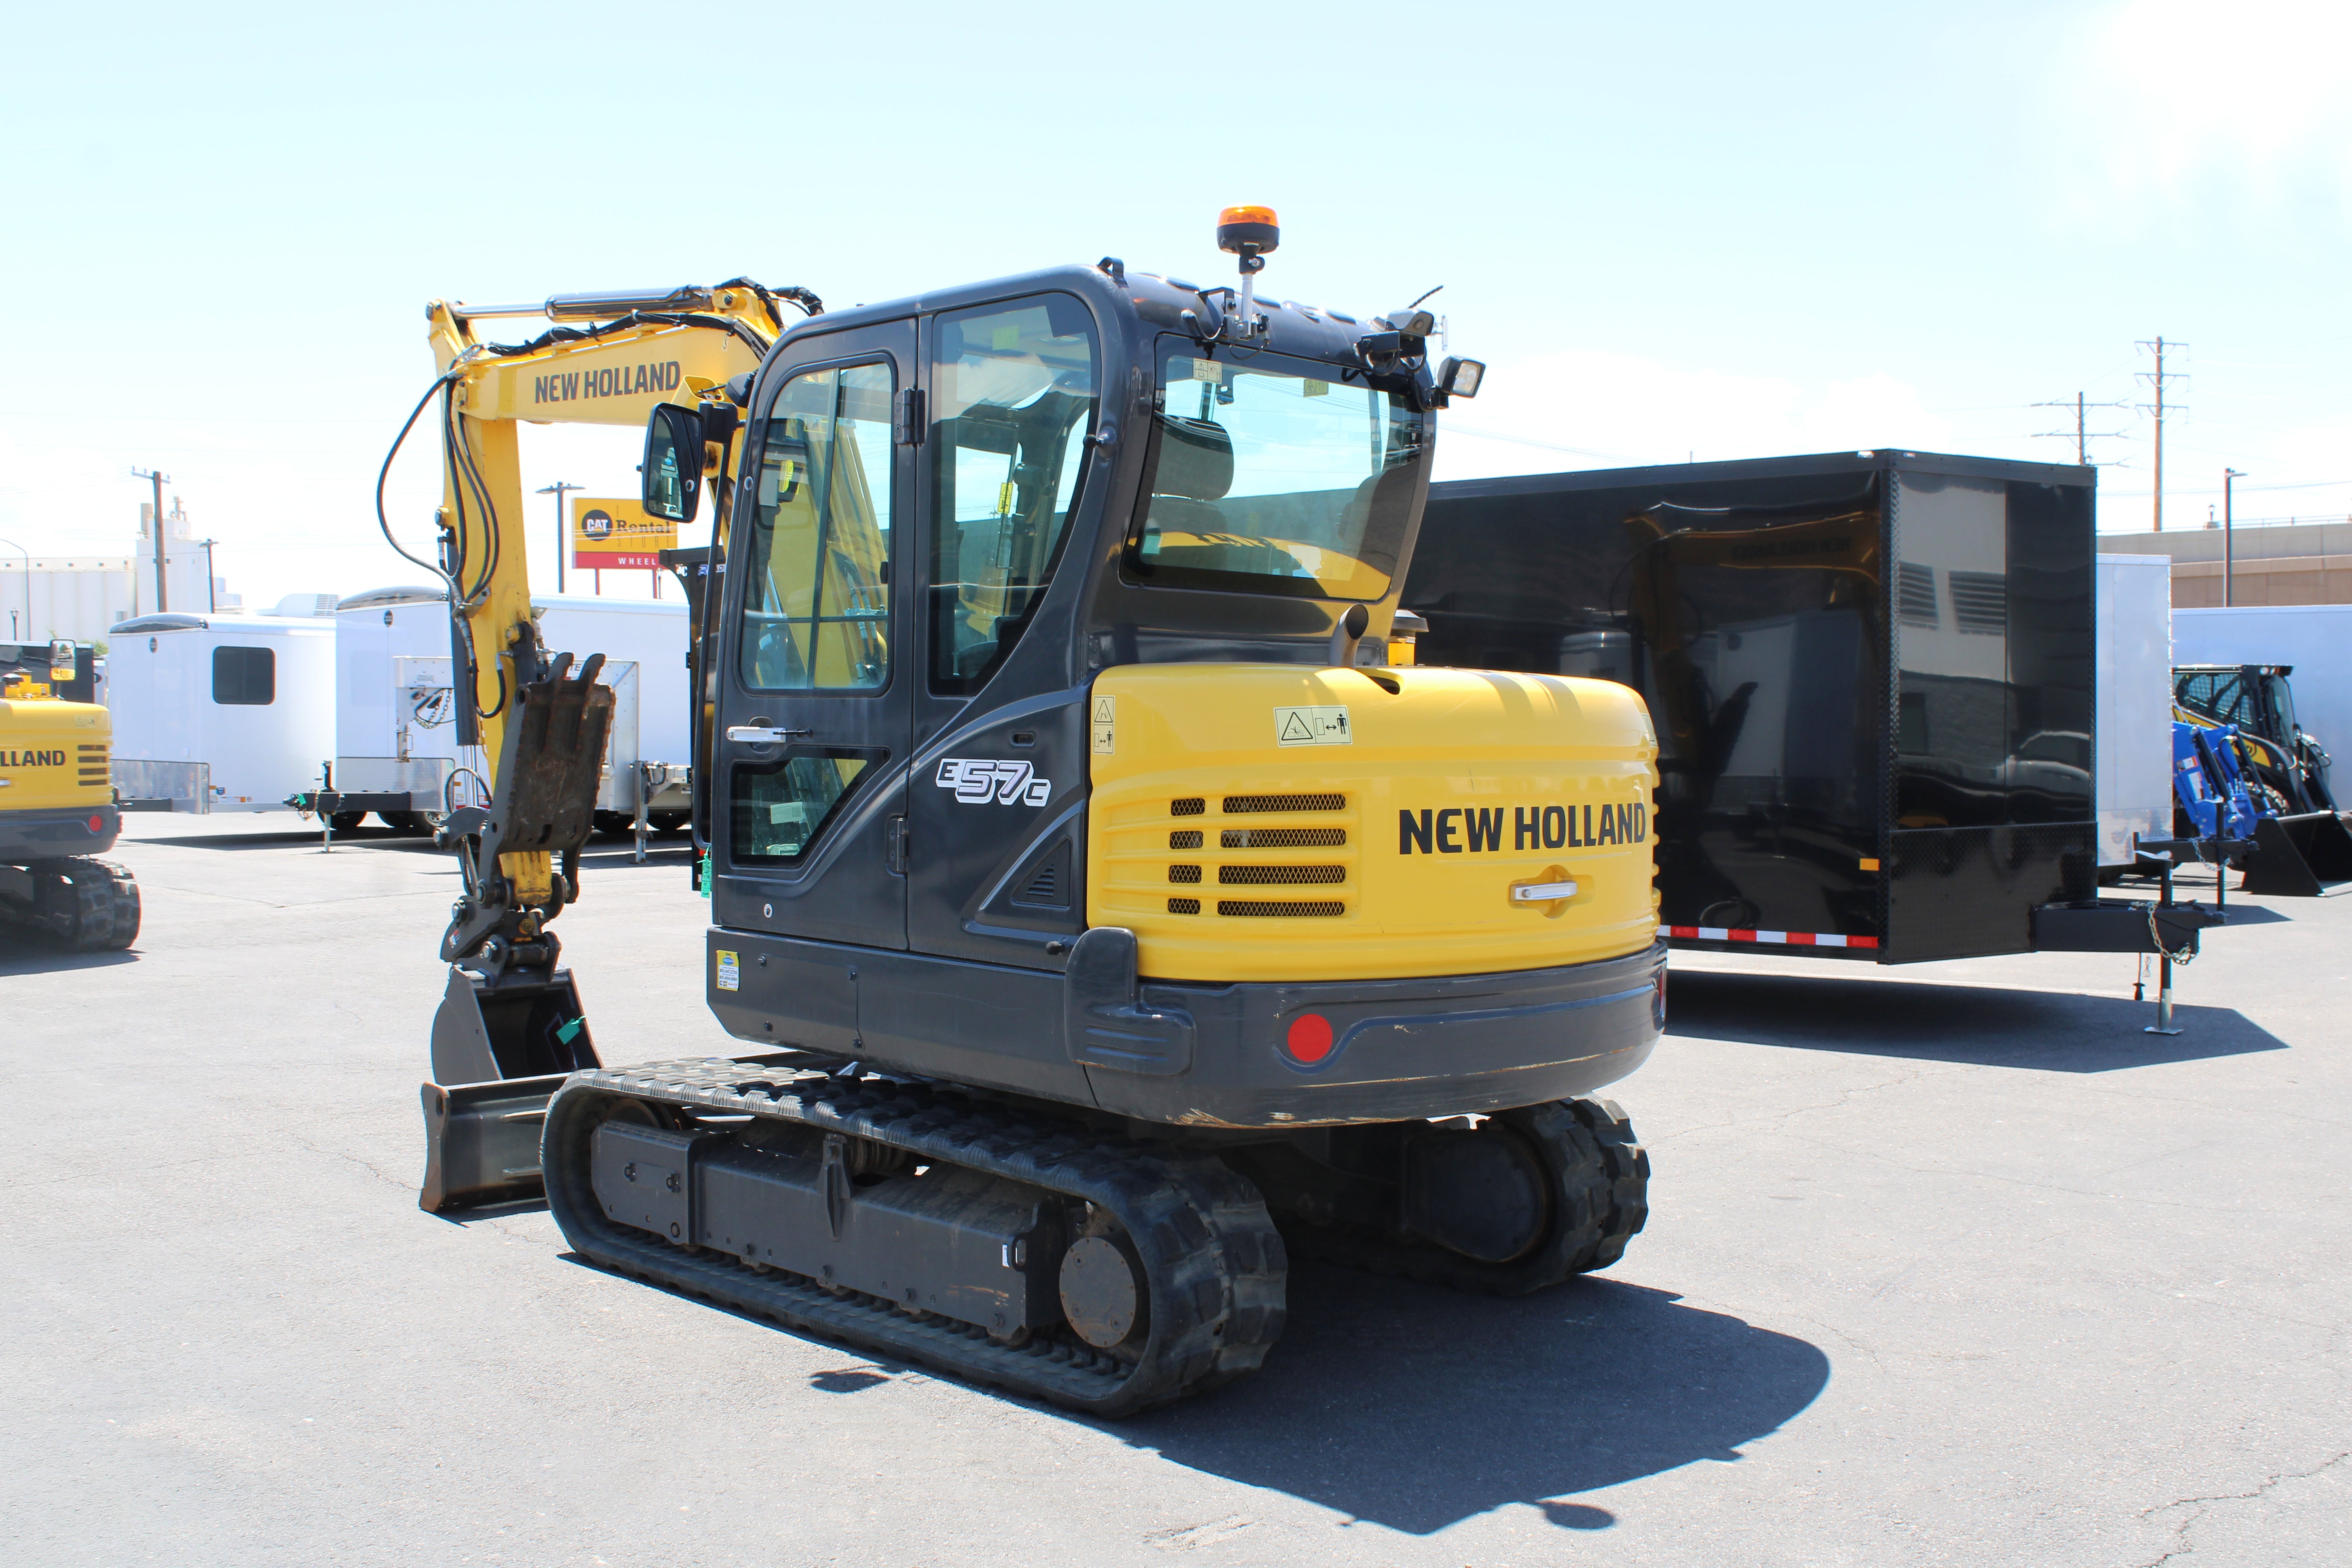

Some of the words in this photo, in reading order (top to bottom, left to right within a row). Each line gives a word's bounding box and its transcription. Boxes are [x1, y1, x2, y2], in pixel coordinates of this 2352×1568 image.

[535, 372, 579, 403] NEW
[584, 361, 681, 399] HOLLAND
[616, 505, 646, 518] TH
[587, 518, 608, 532] CAT
[616, 520, 671, 533] Rental
[617, 535, 671, 548] STORE
[618, 557, 657, 566] WHEEL
[0, 750, 66, 766] LLAND
[936, 759, 1051, 806] E57C
[1399, 807, 1504, 854] NEW
[1515, 803, 1646, 850] HOLLAND
